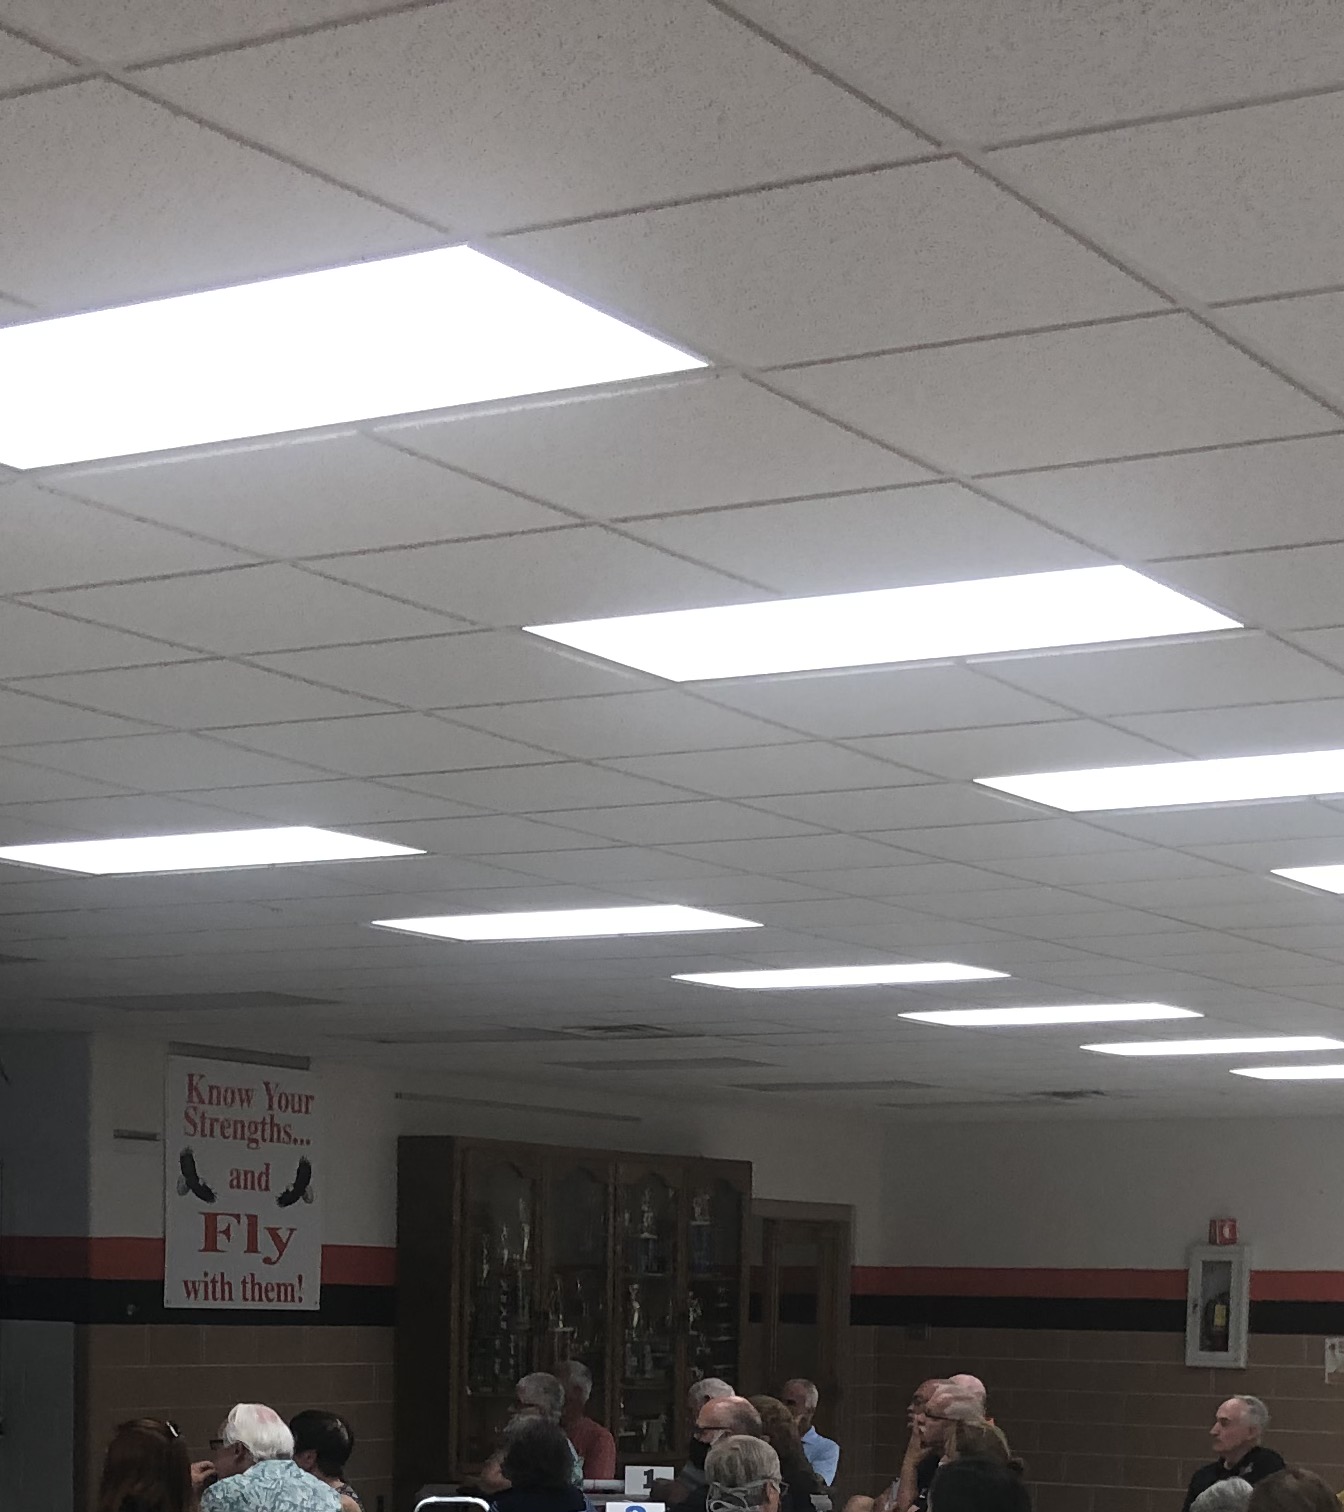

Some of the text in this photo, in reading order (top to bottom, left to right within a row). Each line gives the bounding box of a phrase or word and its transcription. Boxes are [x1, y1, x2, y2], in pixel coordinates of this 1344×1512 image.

[186, 1073, 315, 1115] Know Your
[184, 1105, 311, 1149] Strengths...
[229, 1162, 271, 1192] and
[198, 1211, 297, 1265] Fly
[183, 1270, 305, 1304] with them!
[643, 1469, 654, 1489] 1
